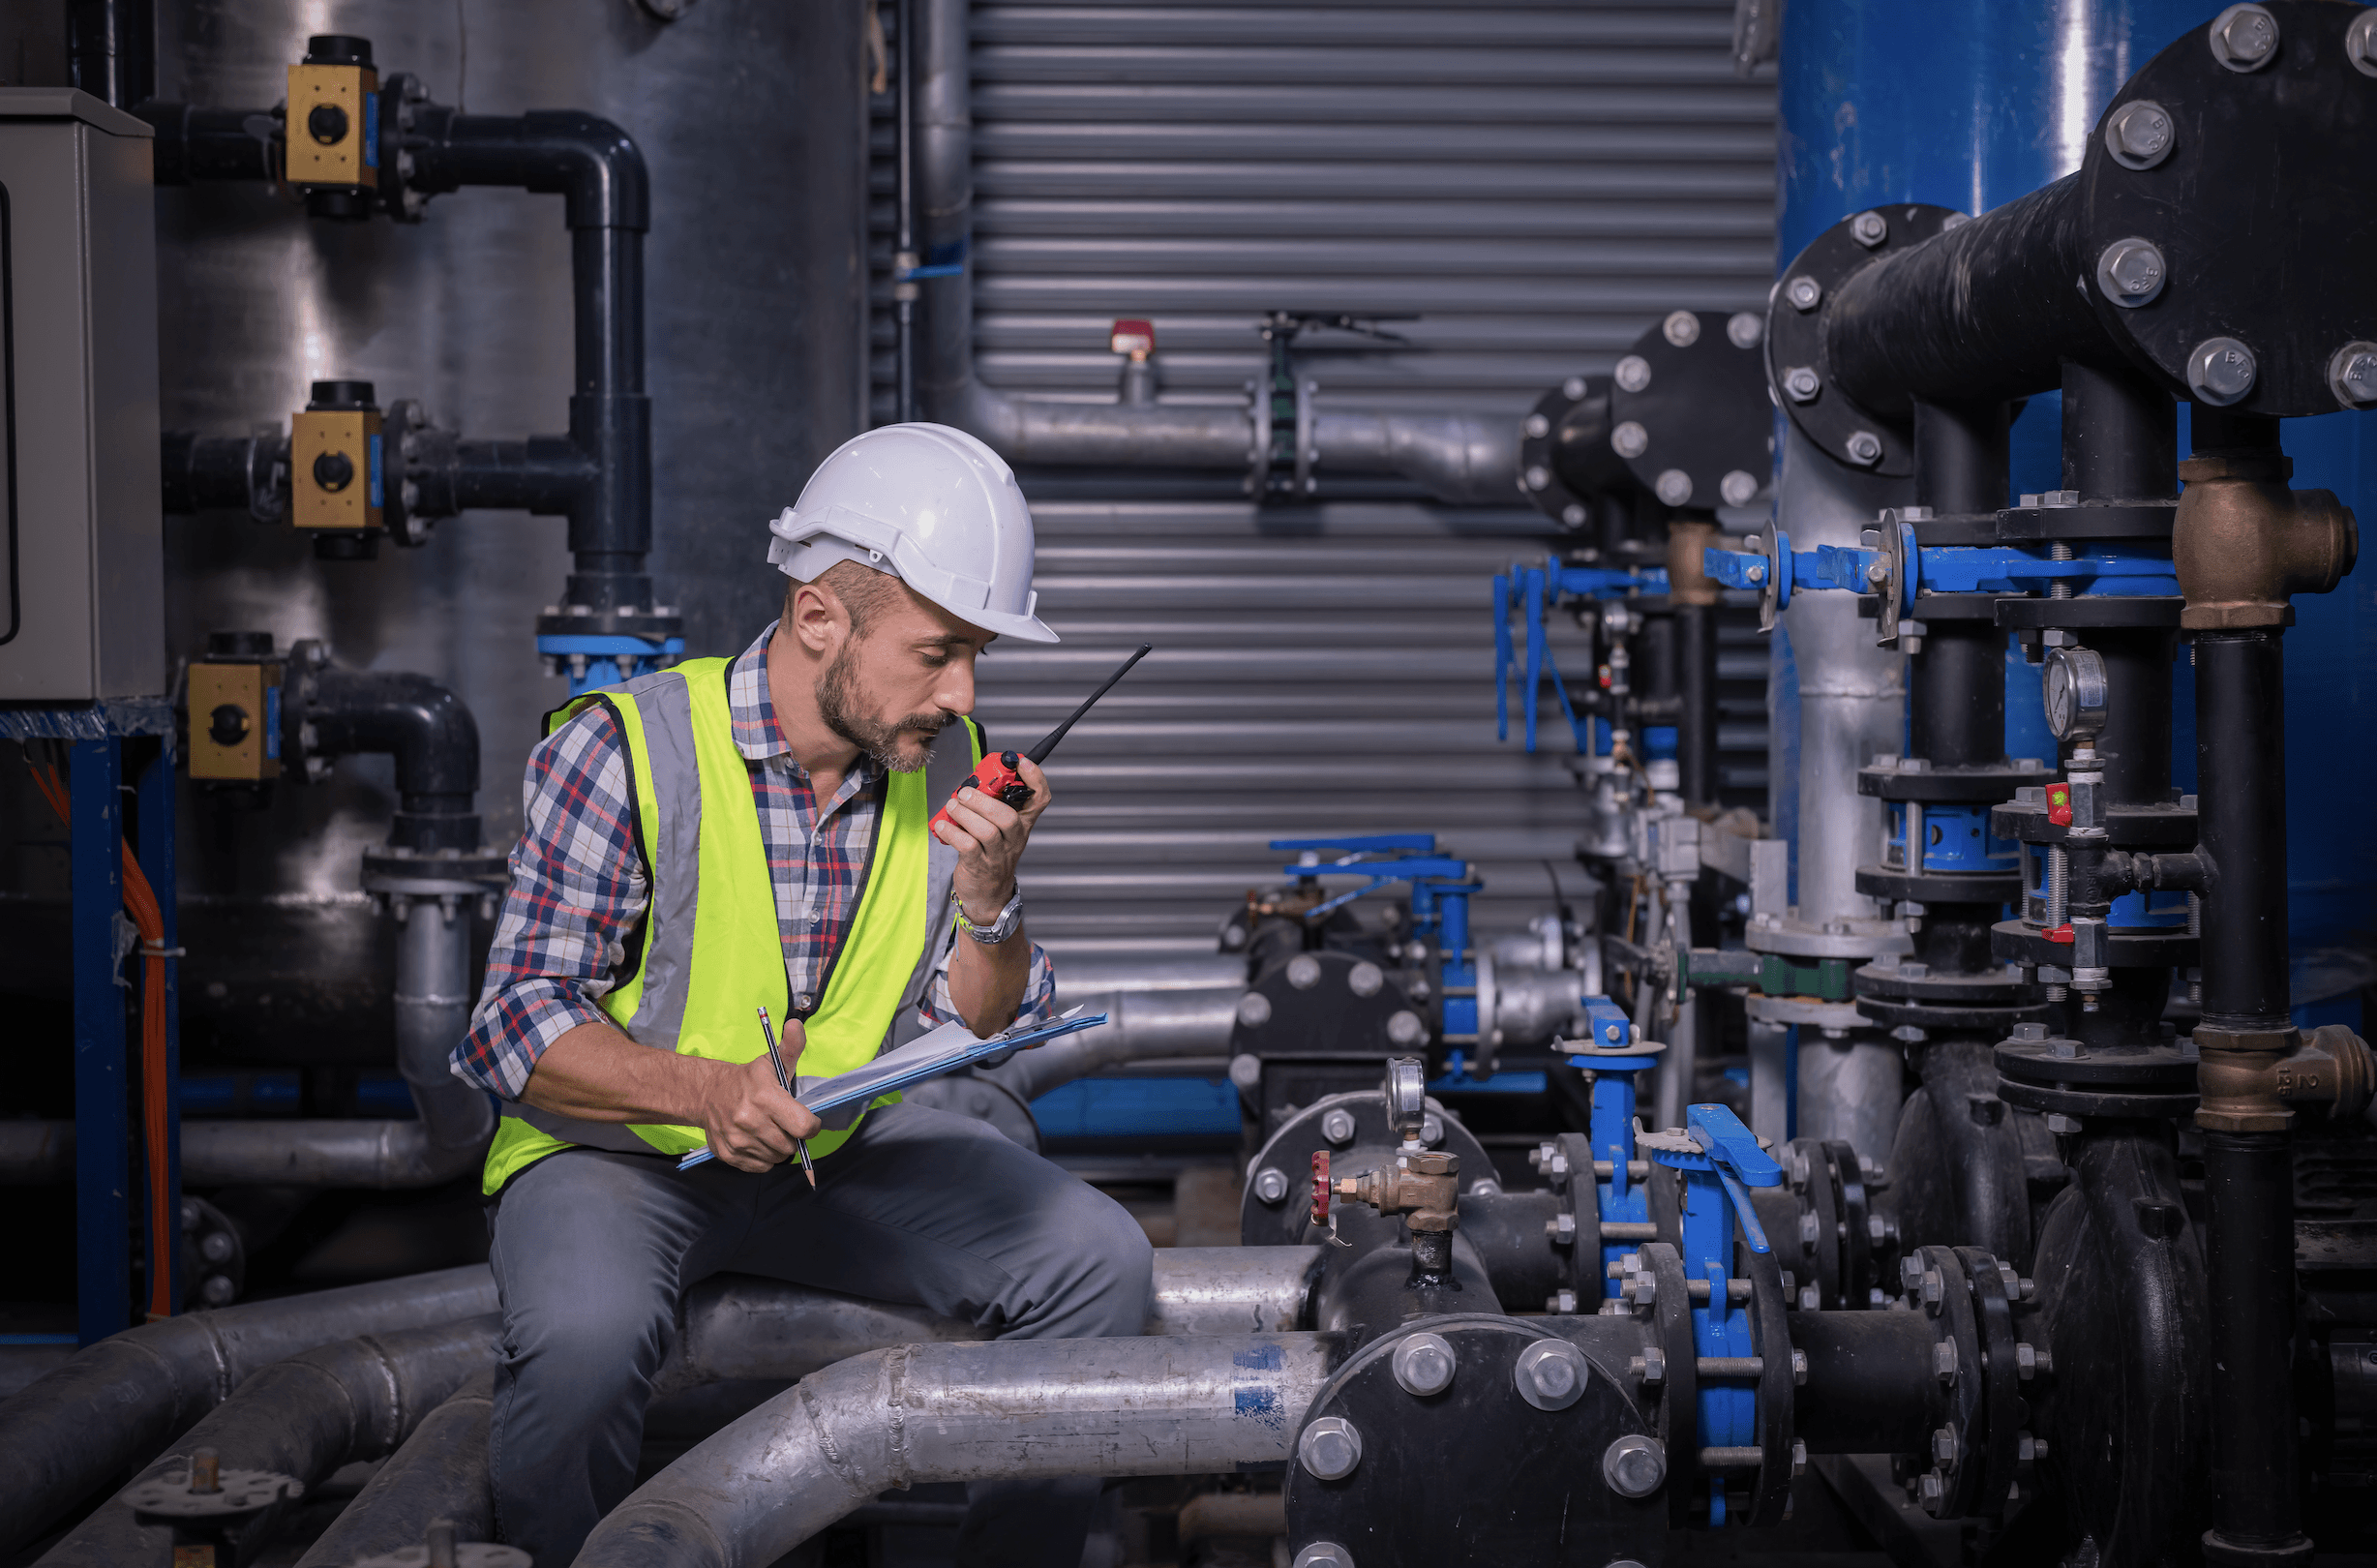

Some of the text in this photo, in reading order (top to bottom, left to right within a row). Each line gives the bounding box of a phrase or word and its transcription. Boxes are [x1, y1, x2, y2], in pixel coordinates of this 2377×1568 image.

[2147, 117, 2167, 152] BFC
[2130, 266, 2159, 291] BFC
[2225, 350, 2250, 378] BFC
[2297, 1073, 2319, 1090] 2
